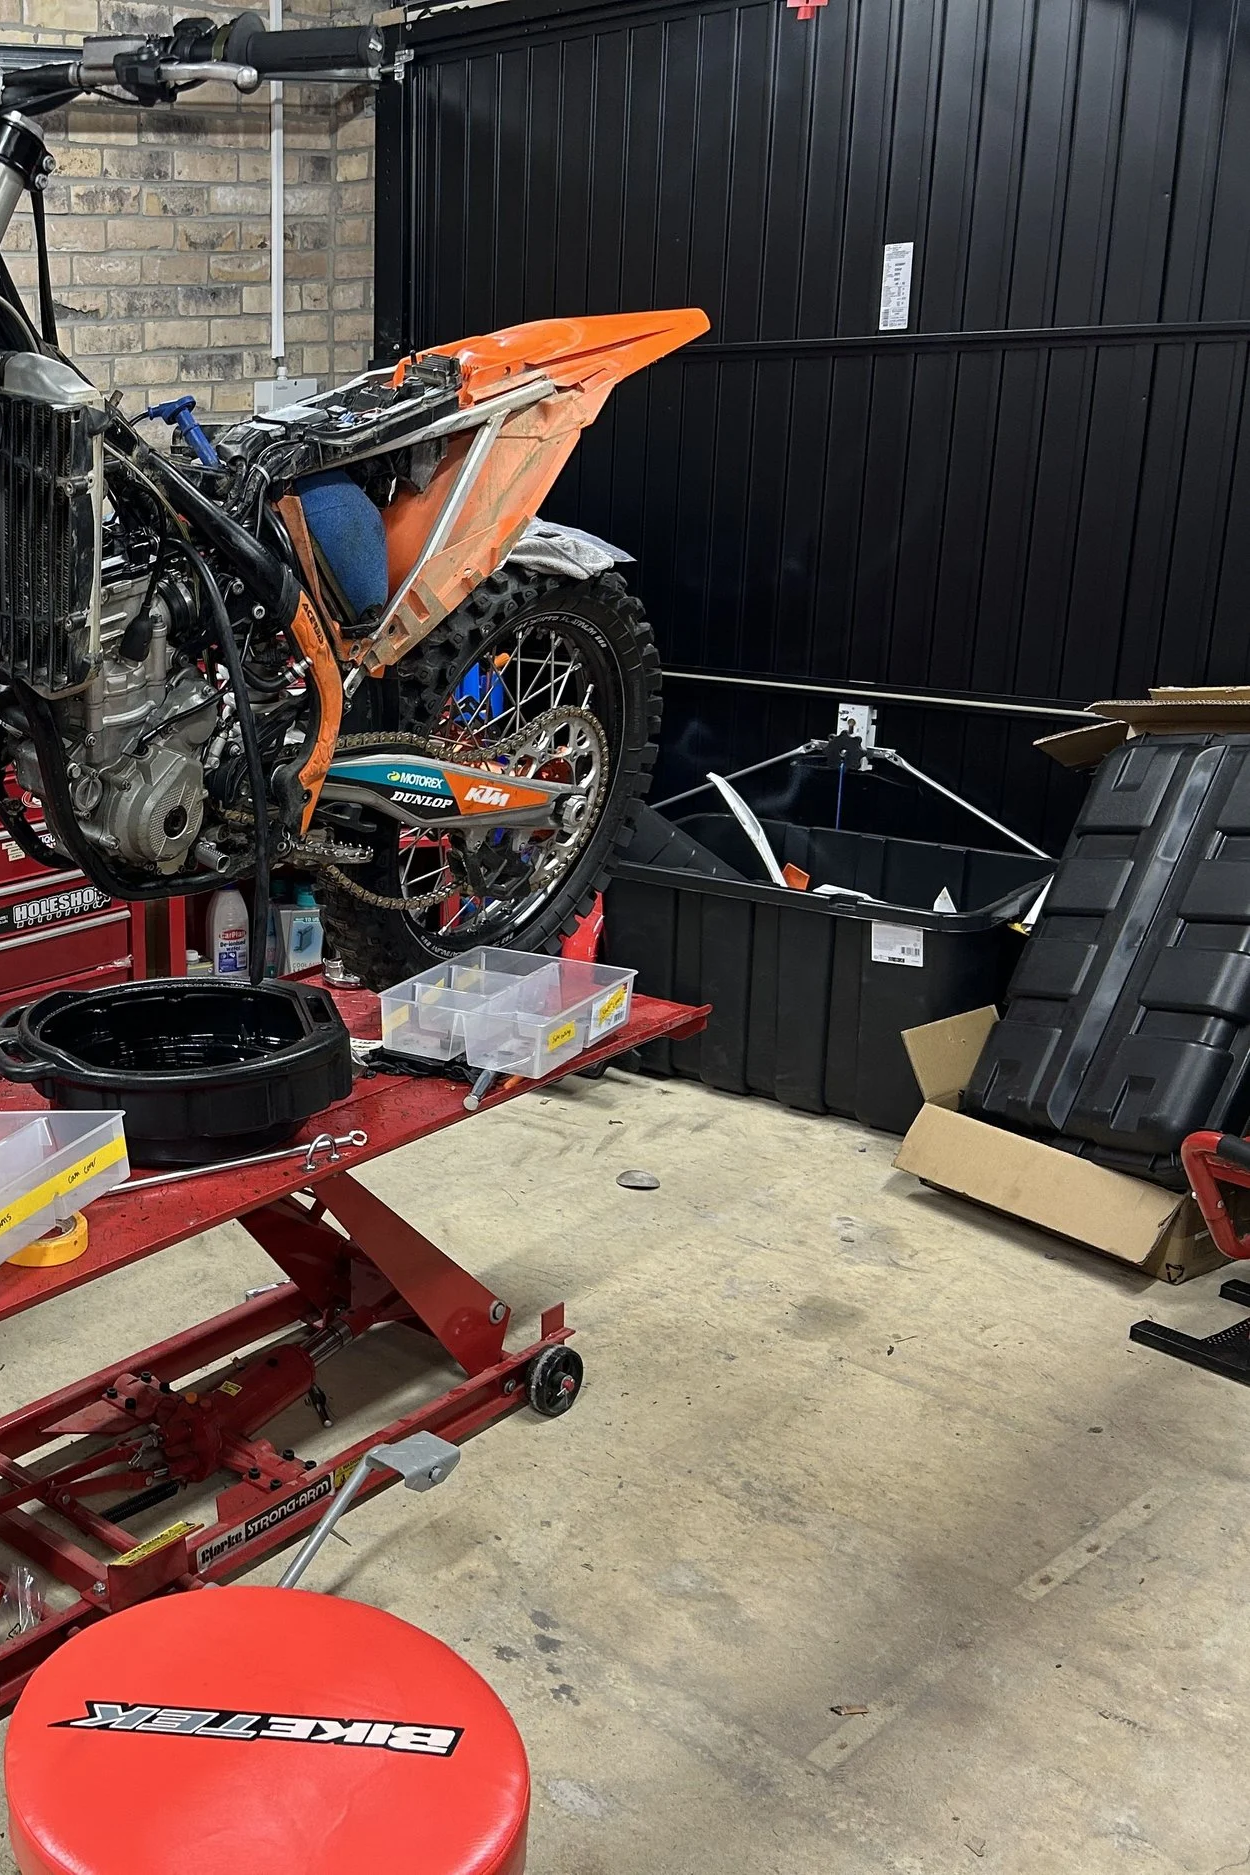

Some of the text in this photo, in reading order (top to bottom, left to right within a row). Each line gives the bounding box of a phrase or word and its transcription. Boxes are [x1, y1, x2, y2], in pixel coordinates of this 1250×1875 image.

[400, 772, 444, 789] MOTOREX
[390, 791, 453, 809] DUNLOP
[464, 785, 510, 807] KTM
[201, 1531, 243, 1567] Clarke
[71, 1702, 457, 1754] BIKETEK
